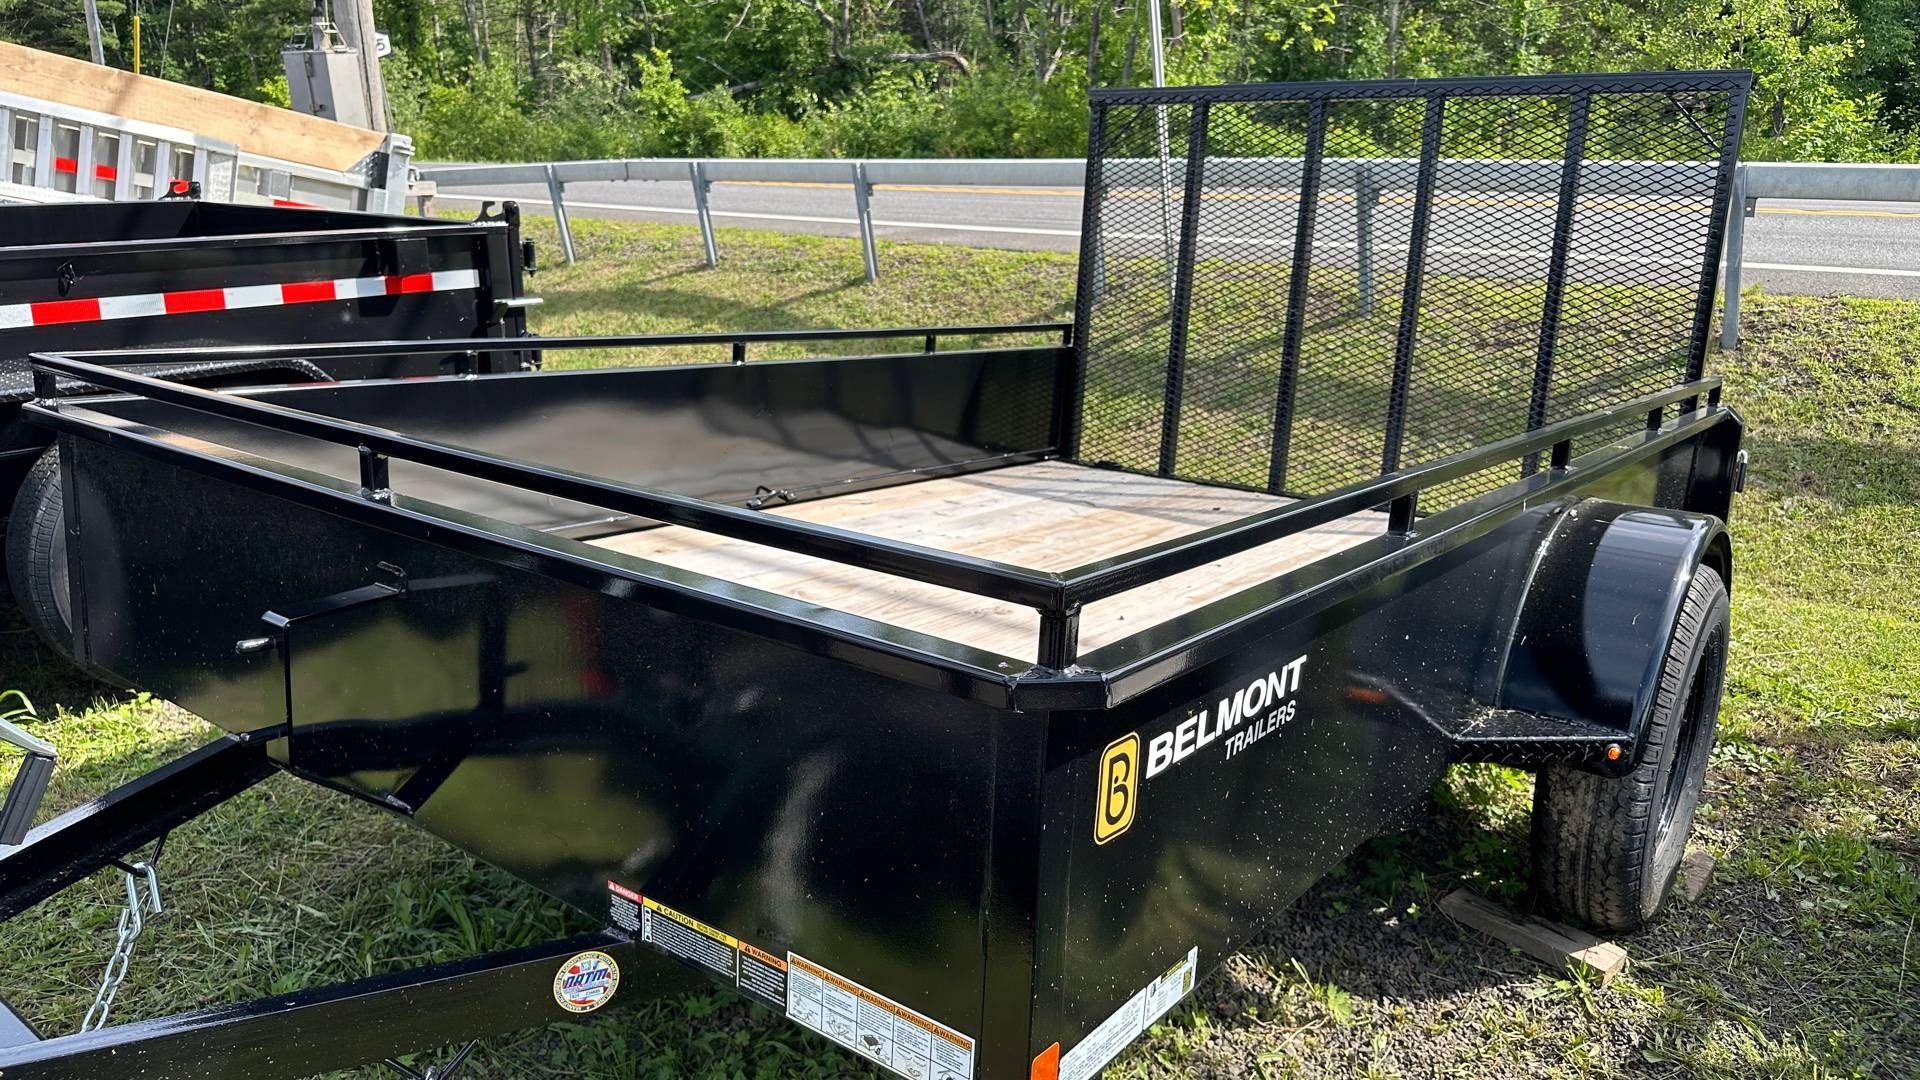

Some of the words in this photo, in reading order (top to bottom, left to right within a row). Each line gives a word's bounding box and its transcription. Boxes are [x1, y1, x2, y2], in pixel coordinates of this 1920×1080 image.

[376, 38, 386, 51] 5
[1146, 654, 1308, 779] BELMONT
[1225, 699, 1296, 760] TRAILERS
[615, 885, 639, 900] DANGER
[663, 907, 694, 927] CAUTION
[751, 948, 782, 967] WARNING
[795, 959, 823, 977] WARNING
[830, 977, 857, 994] WARNING
[864, 993, 894, 1012] WARNING
[900, 1011, 931, 1030] WARNING
[938, 1029, 971, 1049] WARNING
